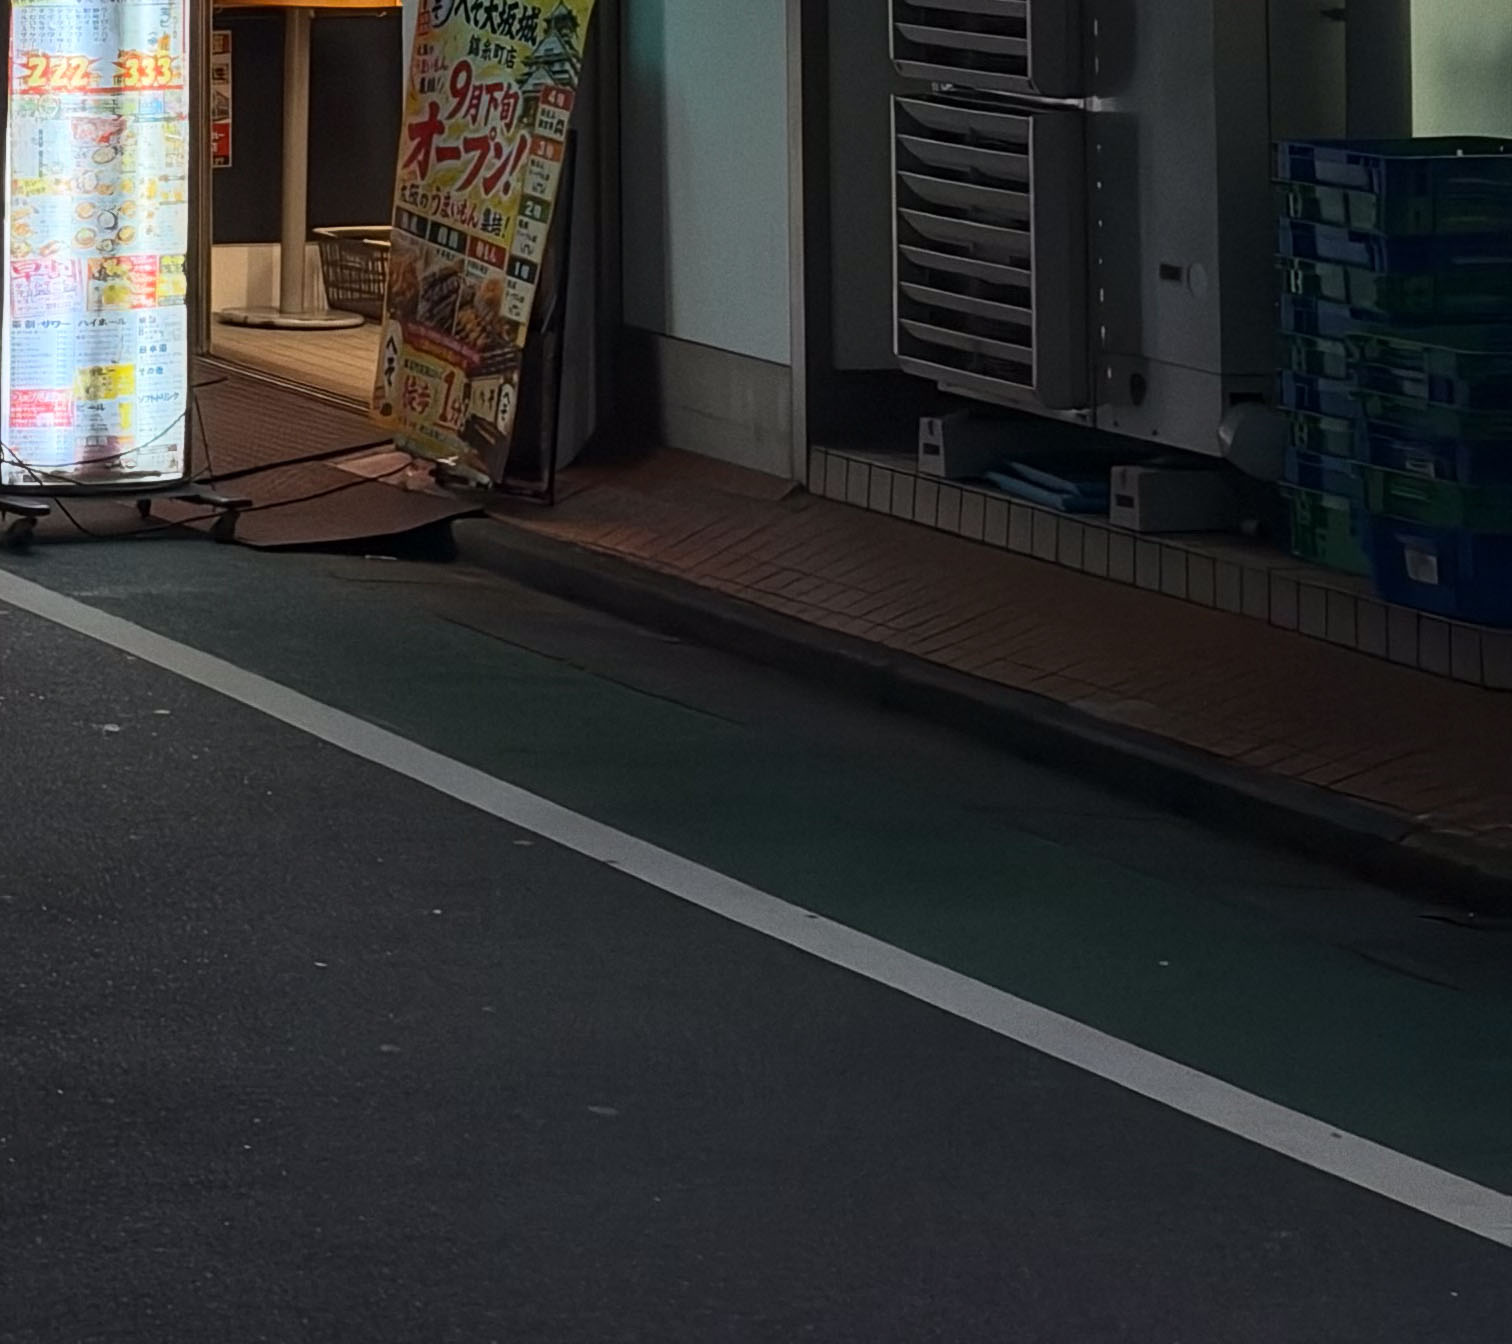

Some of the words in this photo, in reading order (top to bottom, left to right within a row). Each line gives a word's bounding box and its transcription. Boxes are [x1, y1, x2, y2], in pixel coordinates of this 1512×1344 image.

[468, 35, 518, 69] 錦糸町店
[29, 56, 90, 87] 222
[123, 57, 173, 85] 333
[450, 59, 521, 134] 9月下旬
[78, 317, 127, 328] ハイボール
